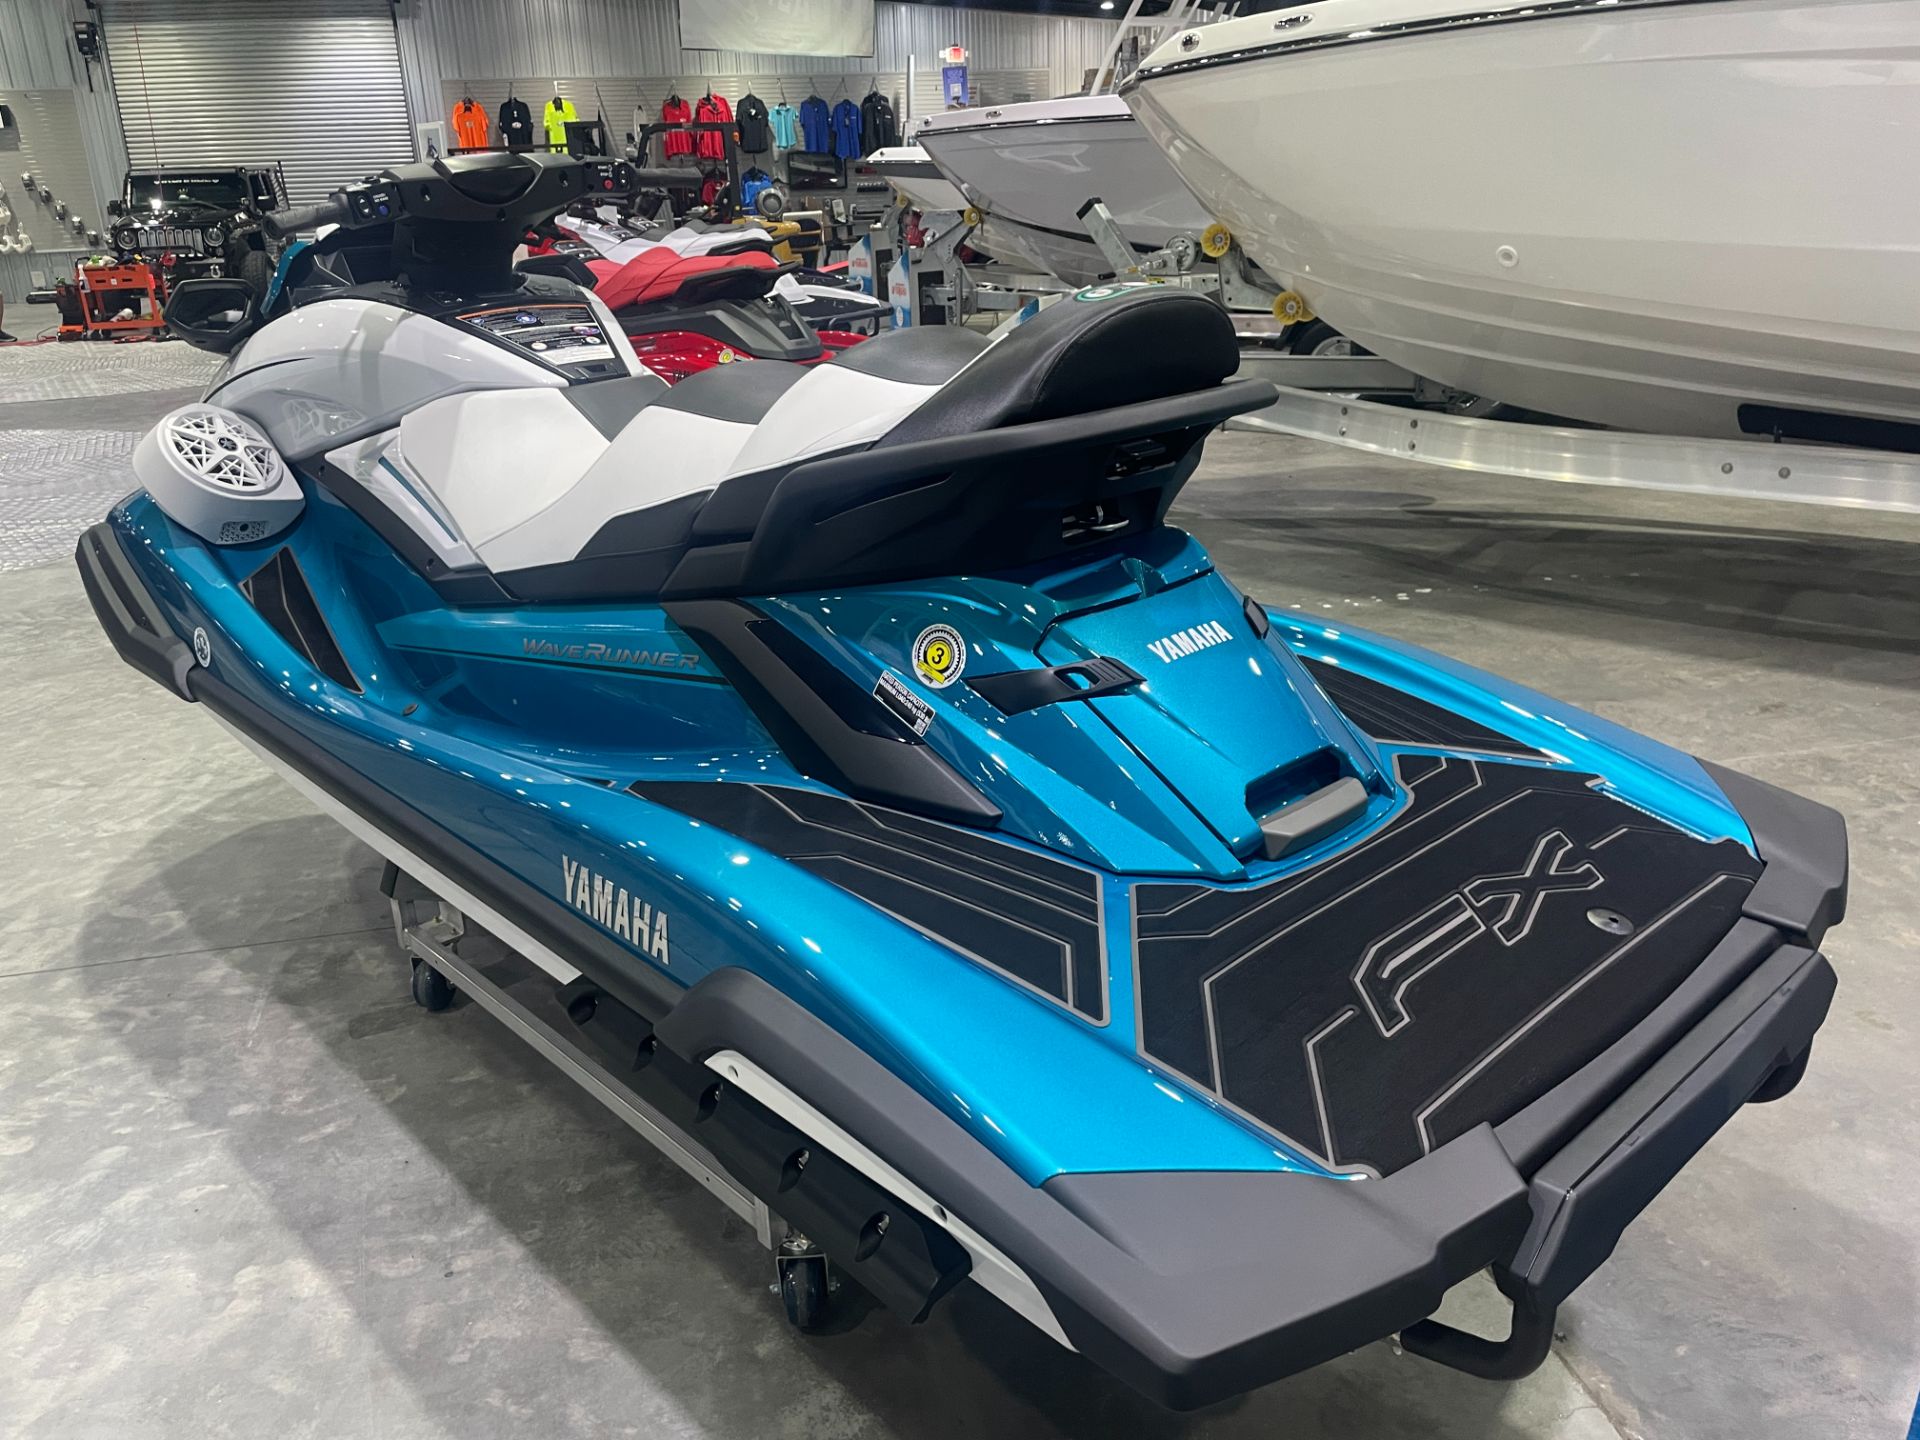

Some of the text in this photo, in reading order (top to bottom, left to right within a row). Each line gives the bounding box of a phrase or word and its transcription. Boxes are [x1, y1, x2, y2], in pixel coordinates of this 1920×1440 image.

[931, 647, 945, 665] 3
[1146, 620, 1234, 664] YAMAHA
[562, 854, 669, 965] YAMAHA
[1354, 831, 1605, 1037] FX
